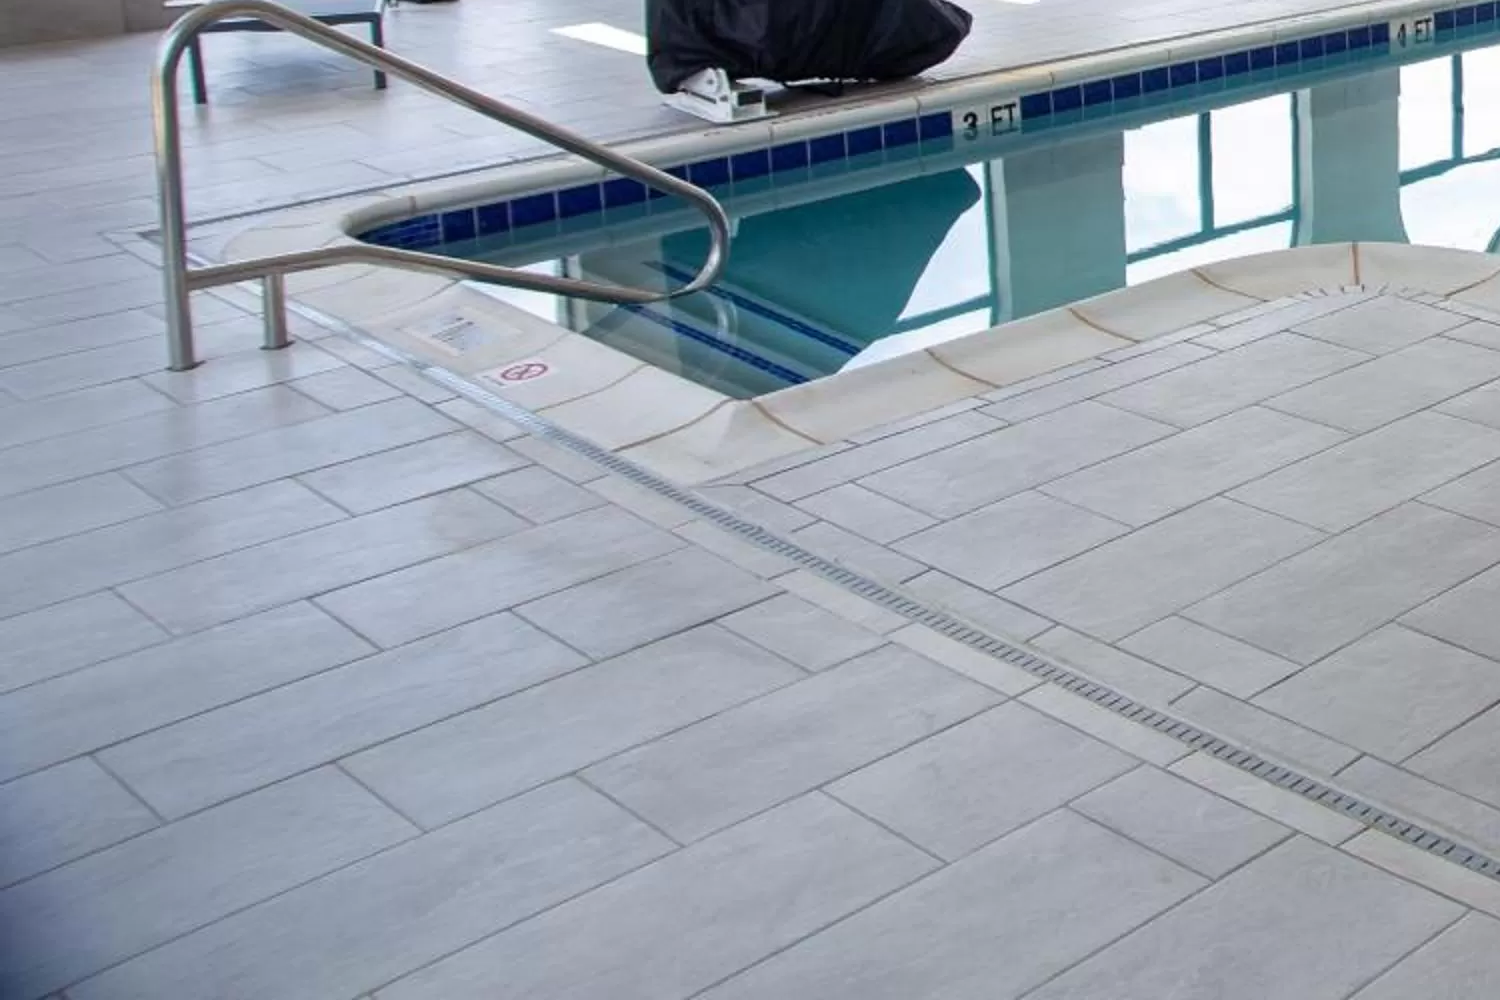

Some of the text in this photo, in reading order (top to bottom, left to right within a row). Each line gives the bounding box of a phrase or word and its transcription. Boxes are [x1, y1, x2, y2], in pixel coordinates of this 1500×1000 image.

[1415, 17, 1432, 44] FT
[963, 102, 1018, 140] 3 FT
